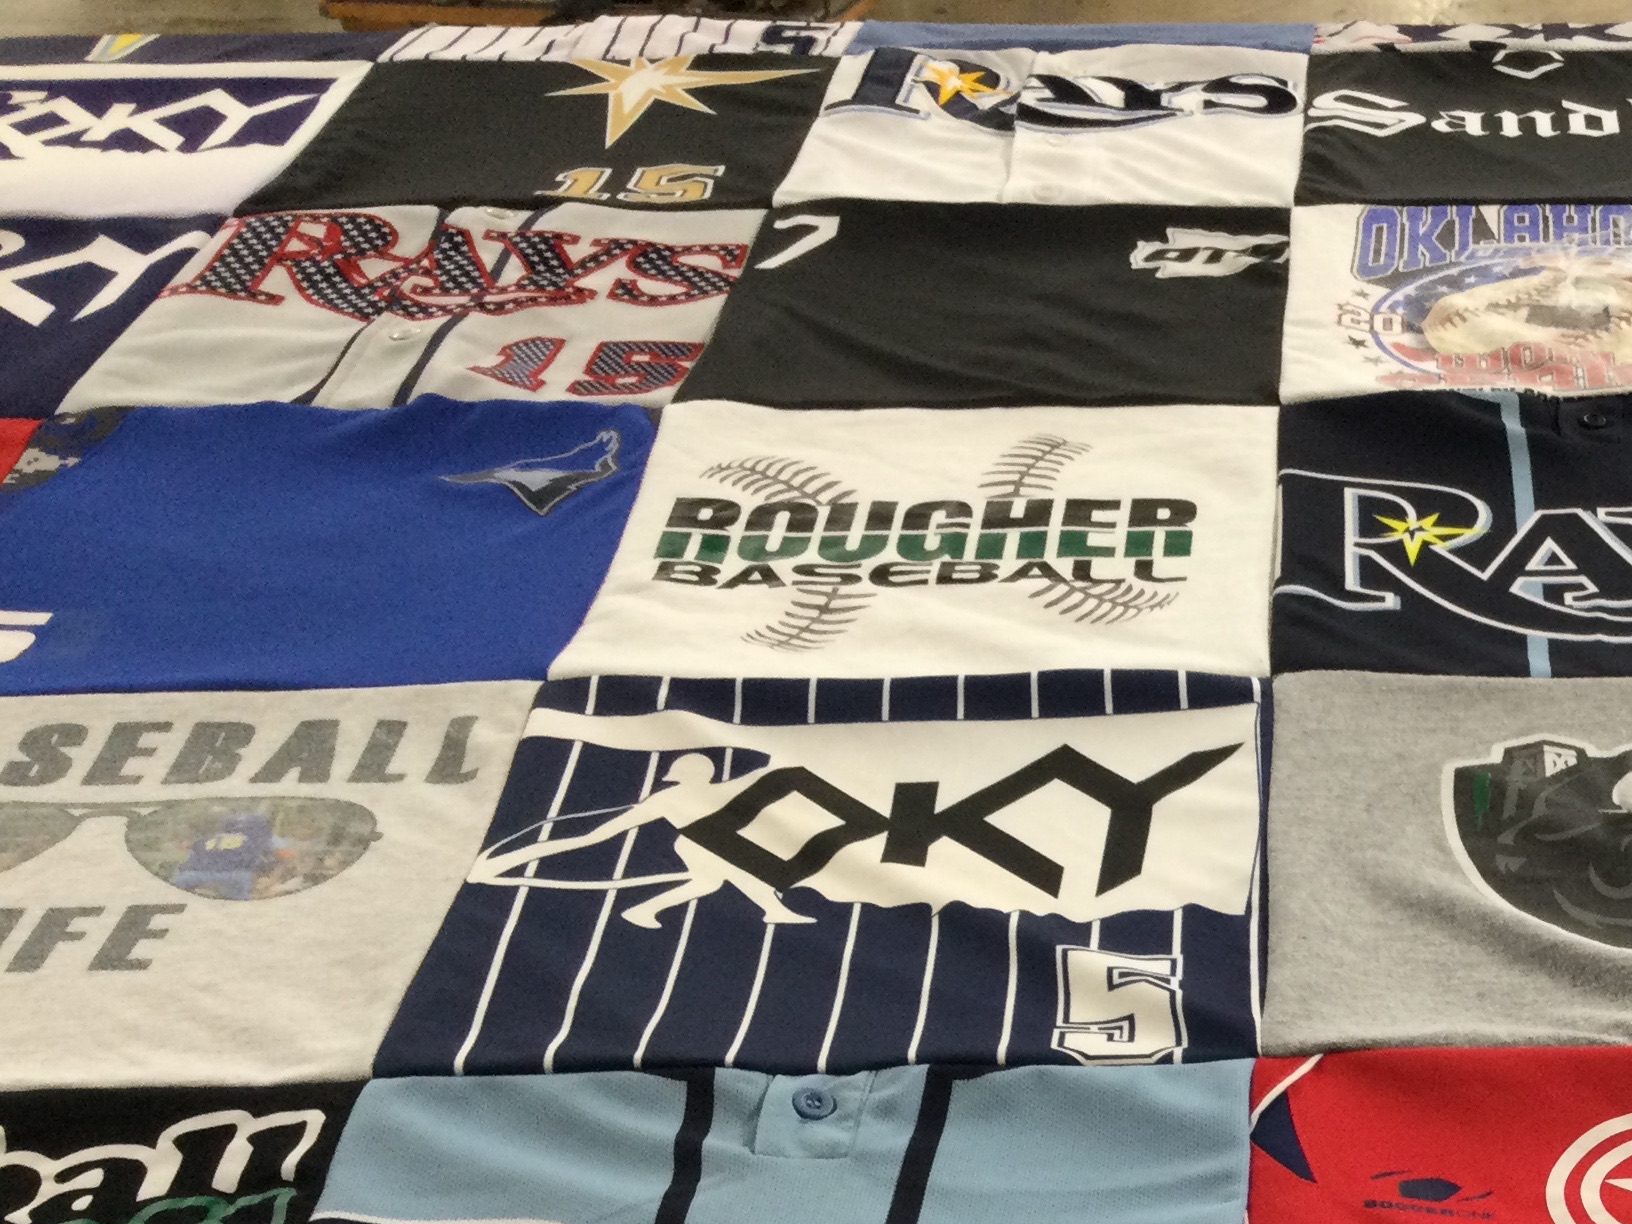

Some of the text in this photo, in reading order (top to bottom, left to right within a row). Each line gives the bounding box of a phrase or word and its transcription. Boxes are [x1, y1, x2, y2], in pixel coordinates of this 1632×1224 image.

[535, 164, 726, 201] 15
[157, 211, 750, 323] RAYS
[467, 337, 705, 397] 15
[653, 496, 1198, 562] ROUGHER
[652, 559, 1188, 589] BASEBALL
[1051, 945, 1187, 1065] 5
